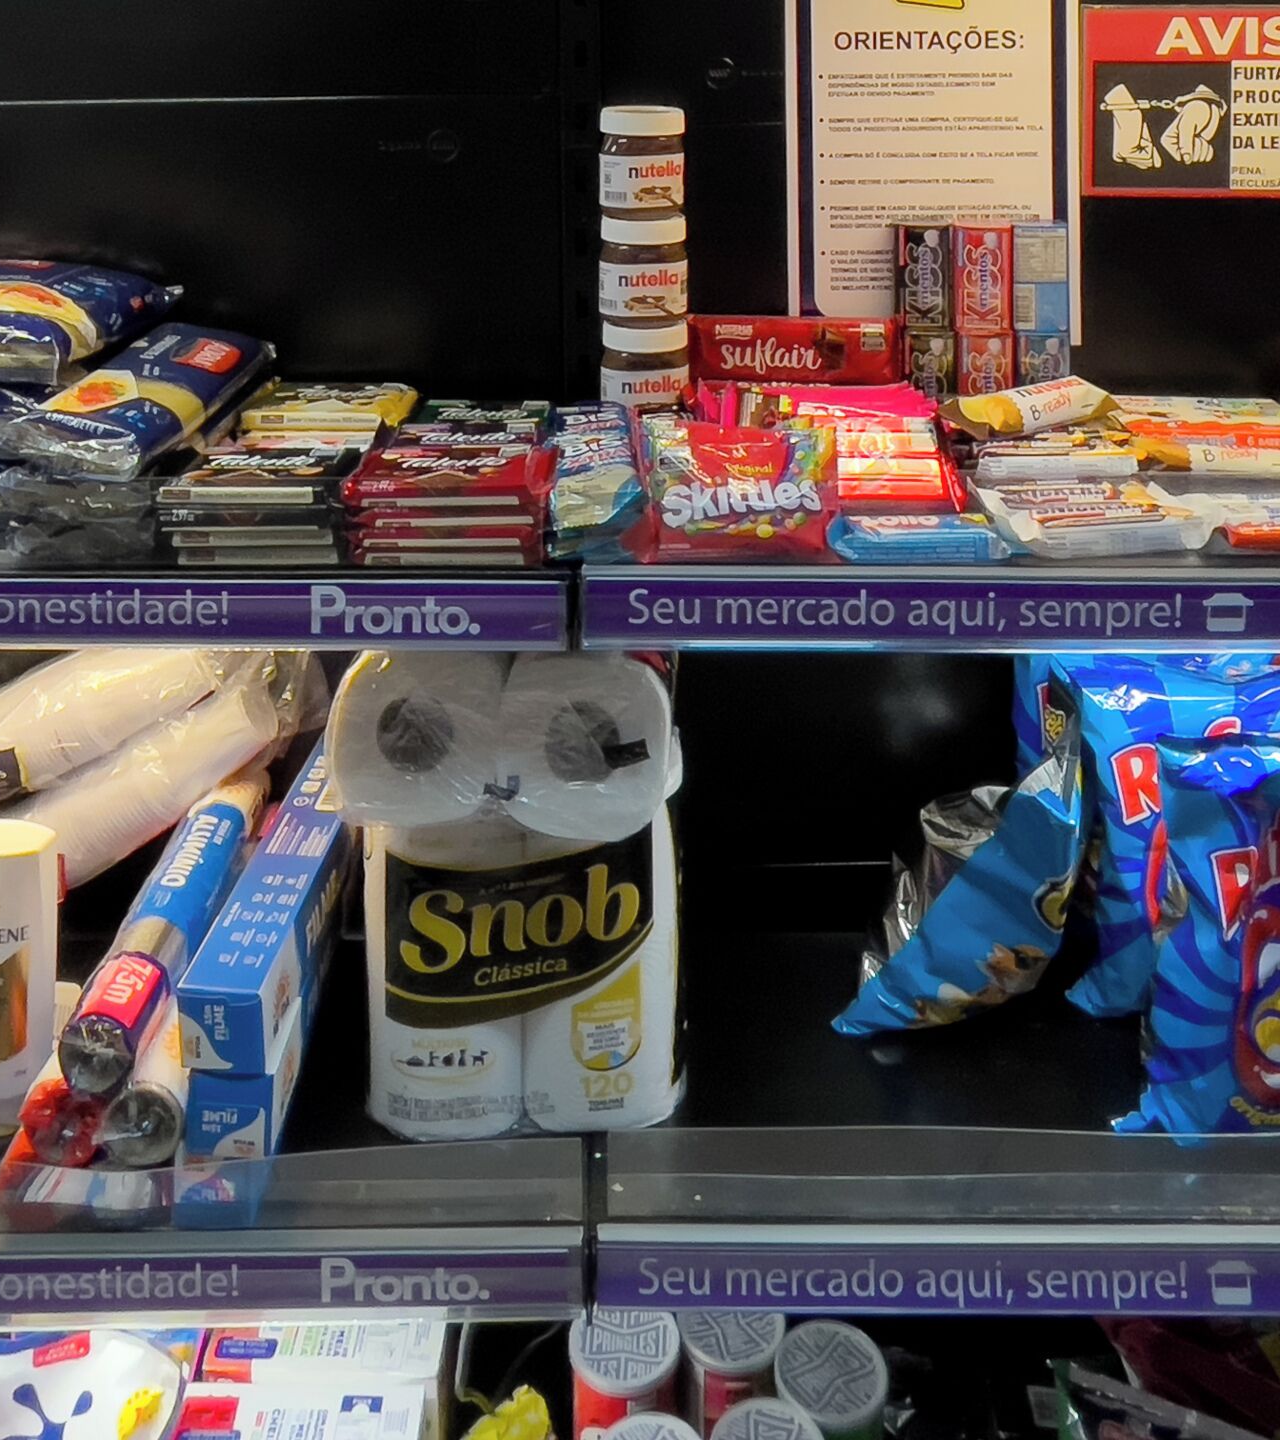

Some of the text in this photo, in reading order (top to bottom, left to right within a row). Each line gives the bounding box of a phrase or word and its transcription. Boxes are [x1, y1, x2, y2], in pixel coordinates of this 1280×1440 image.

[833, 25, 1025, 55] ORIENTAÇÕES:
[1232, 135, 1255, 150] DA
[627, 159, 684, 180] nutella
[1231, 166, 1265, 176] PENA:
[618, 270, 679, 288] nutella
[720, 343, 822, 372] suflair
[621, 376, 682, 395] nutella
[660, 479, 821, 528] Skittles
[310, 586, 481, 636] Pronto.
[627, 589, 1183, 636] Seu mercado aqui, sempre!
[399, 863, 640, 974] Snob
[474, 956, 568, 988] Clássica
[581, 1070, 634, 1098] 120
[320, 1257, 491, 1304] Pronto.
[637, 1259, 1189, 1306] Seu mercado aqui, sempre!
